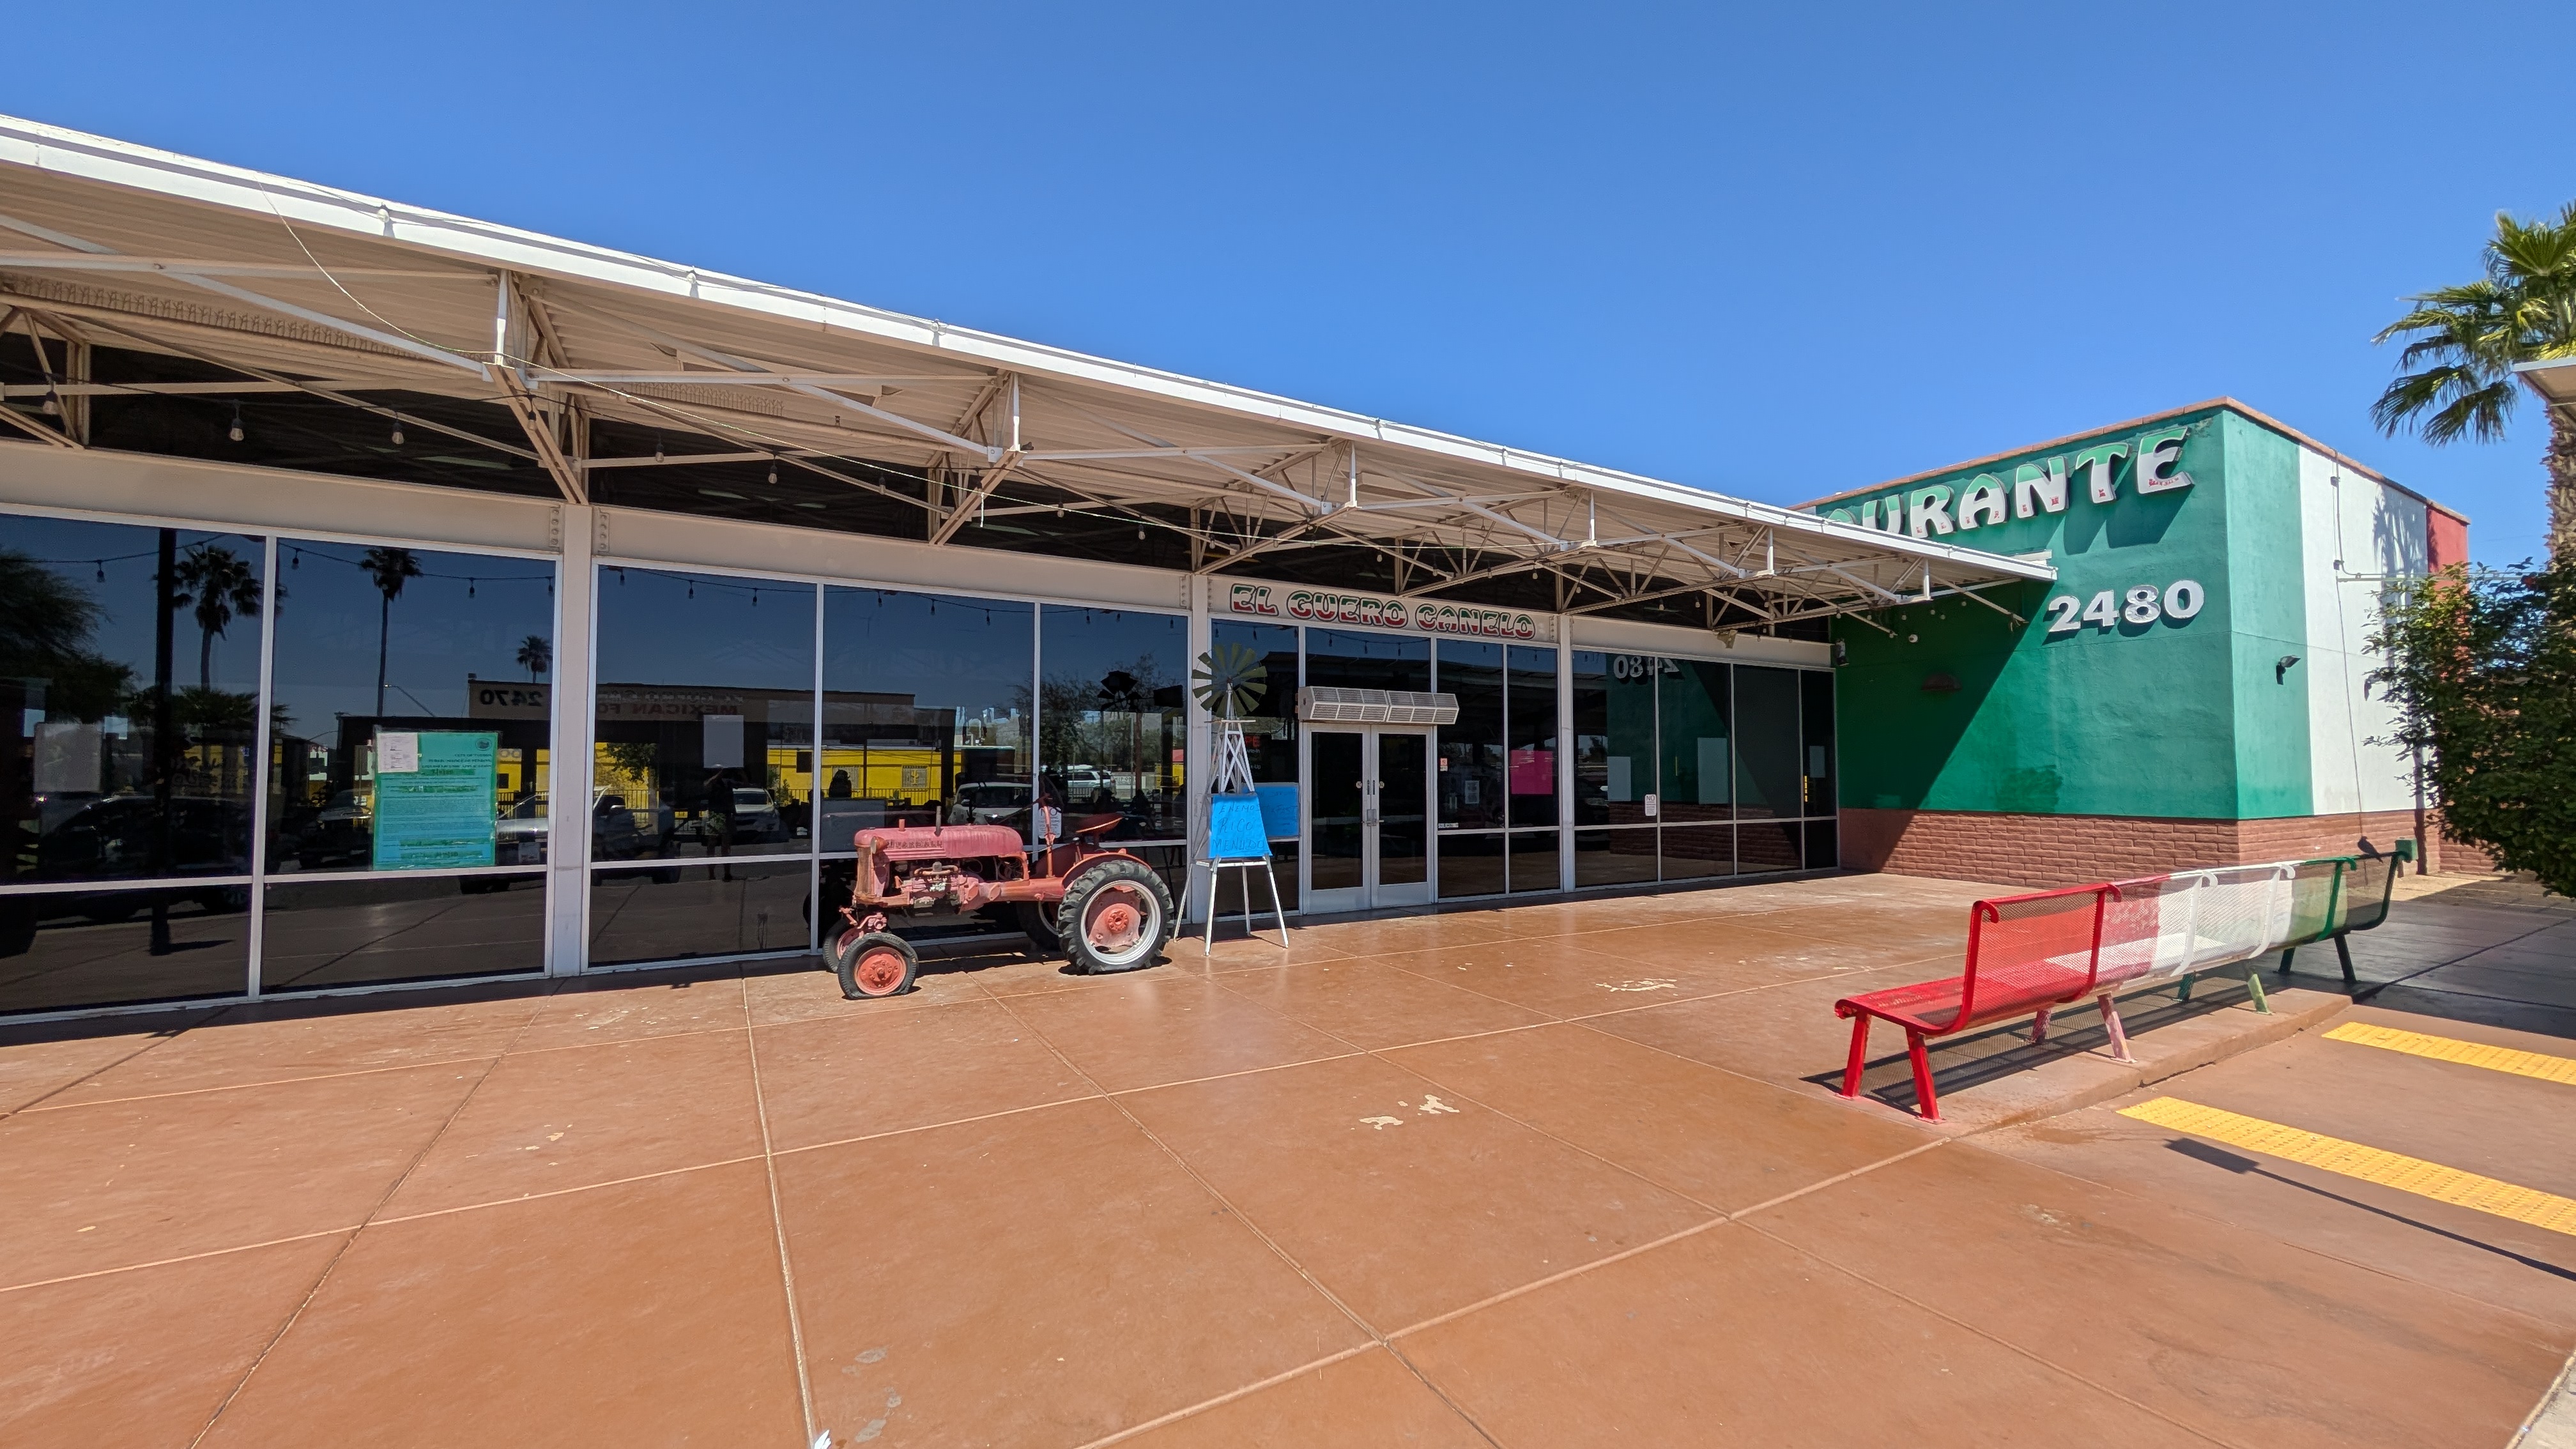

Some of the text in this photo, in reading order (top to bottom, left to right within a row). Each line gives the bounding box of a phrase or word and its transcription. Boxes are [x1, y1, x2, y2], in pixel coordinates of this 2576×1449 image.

[1828, 426, 2195, 539] URANTE
[1230, 583, 1535, 640] EL GUERO CANELO
[2048, 579, 2205, 633] 2480
[1212, 837, 1265, 852] MENUDO
[1217, 816, 1254, 834] RICO
